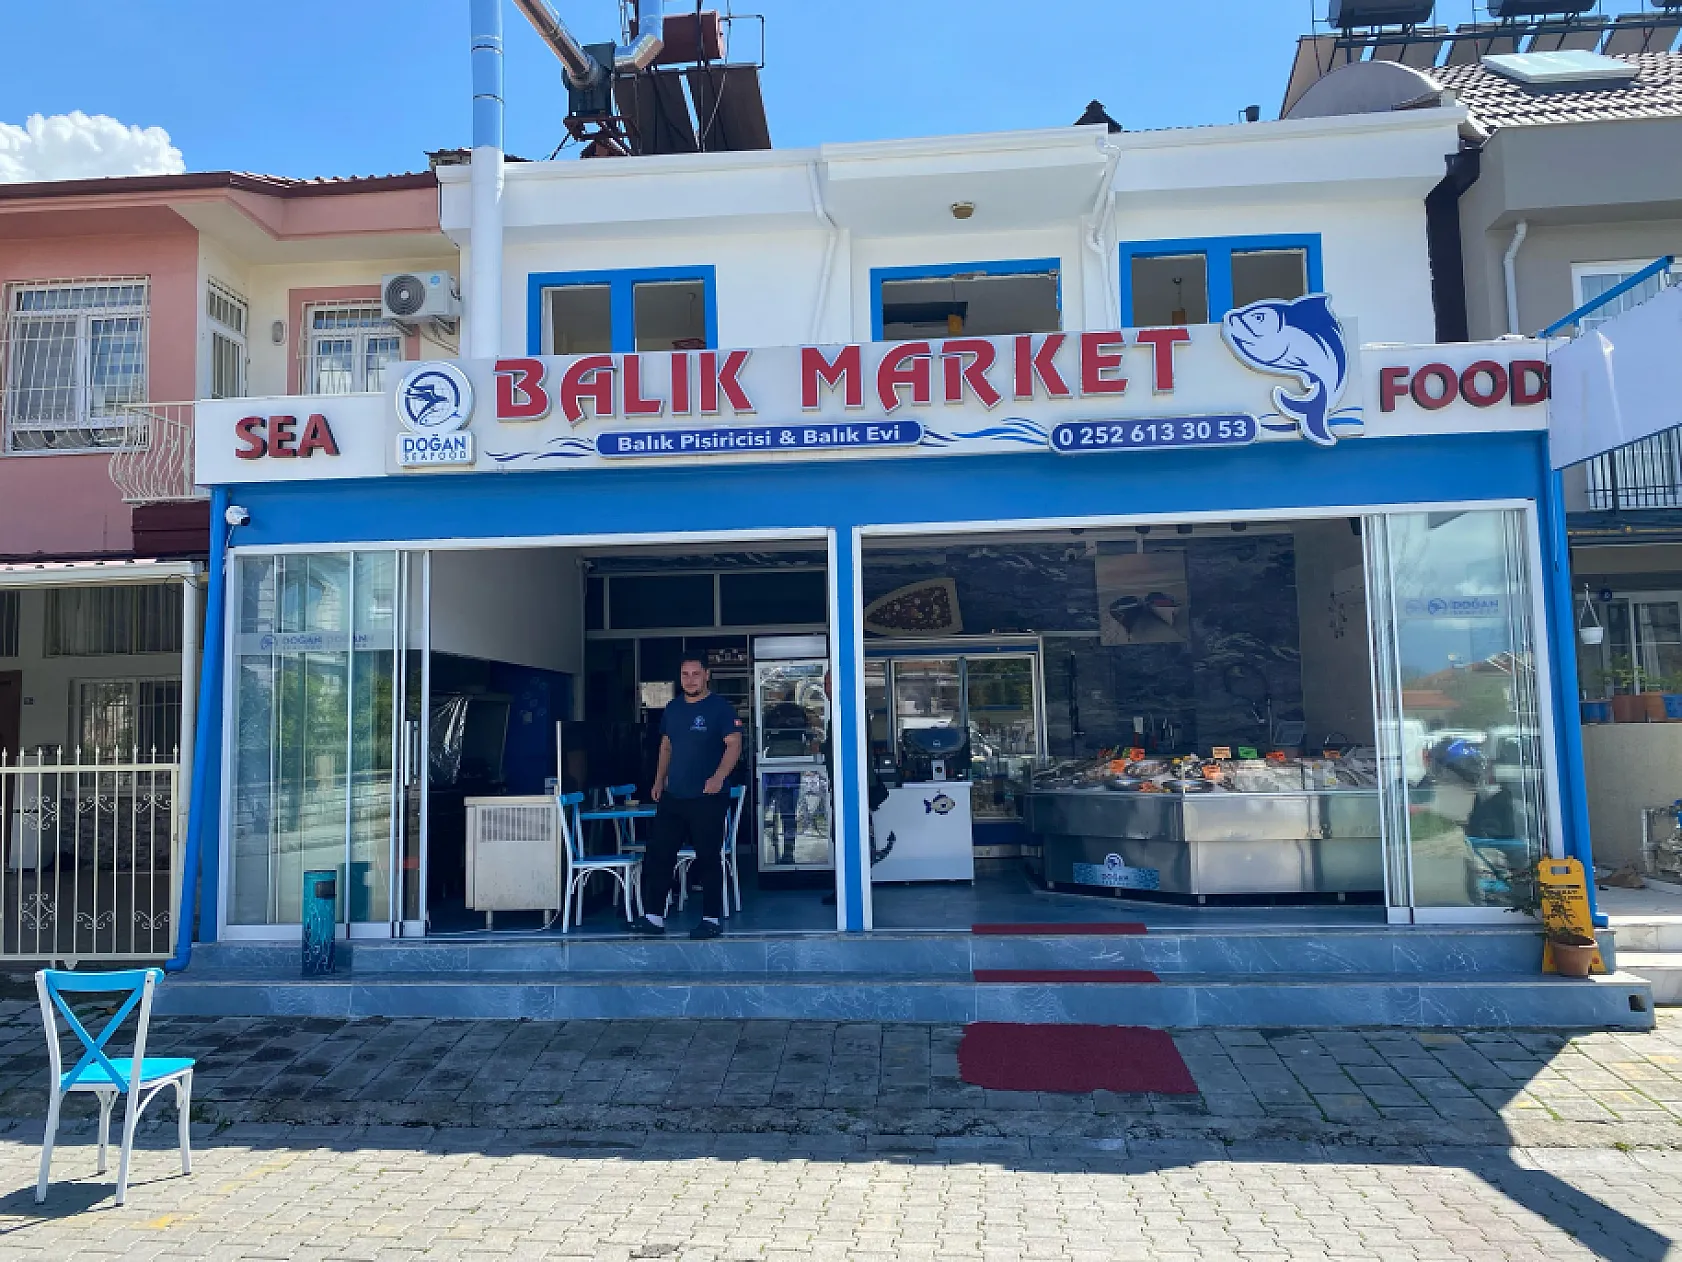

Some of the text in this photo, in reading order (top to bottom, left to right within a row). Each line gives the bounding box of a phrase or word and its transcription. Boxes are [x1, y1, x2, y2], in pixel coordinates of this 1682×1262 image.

[494, 327, 1191, 427] BALIK MARKET
[1379, 360, 1551, 412] FOOD
[235, 414, 340, 459] SEA
[404, 433, 467, 453] DOĞAN
[617, 433, 675, 452] Balık
[778, 429, 797, 445] &
[803, 426, 861, 444] Balık
[866, 424, 901, 441] Evi
[1059, 419, 1248, 446] 0 252 613 30 53
[404, 450, 467, 462] SEAFOOD
